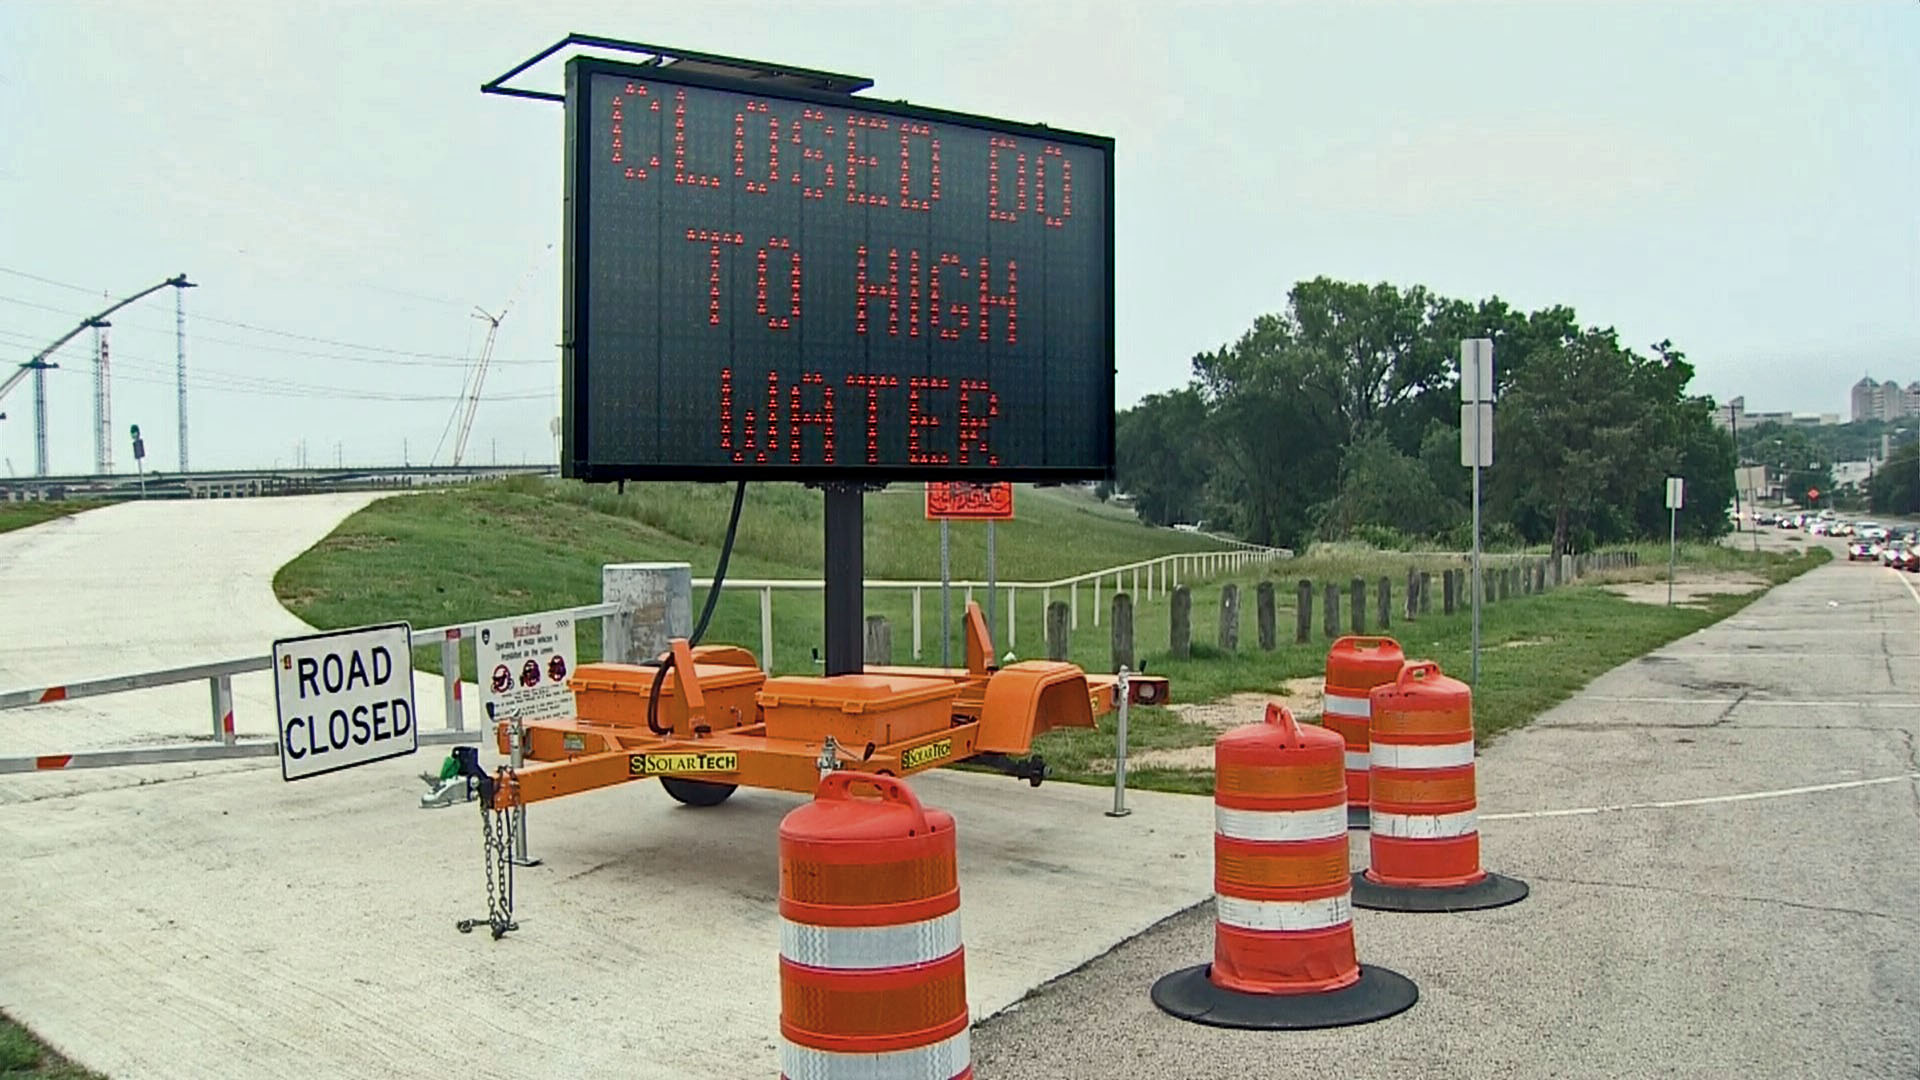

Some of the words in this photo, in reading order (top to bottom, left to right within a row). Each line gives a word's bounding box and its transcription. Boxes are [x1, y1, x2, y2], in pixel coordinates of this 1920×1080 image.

[614, 82, 941, 211] CLOSED
[988, 137, 1073, 228] DO
[686, 229, 802, 330] TO
[857, 244, 1018, 343] HIGH
[719, 367, 1000, 465] WATER
[297, 646, 392, 699] ROAD
[286, 698, 411, 759] CLOSED
